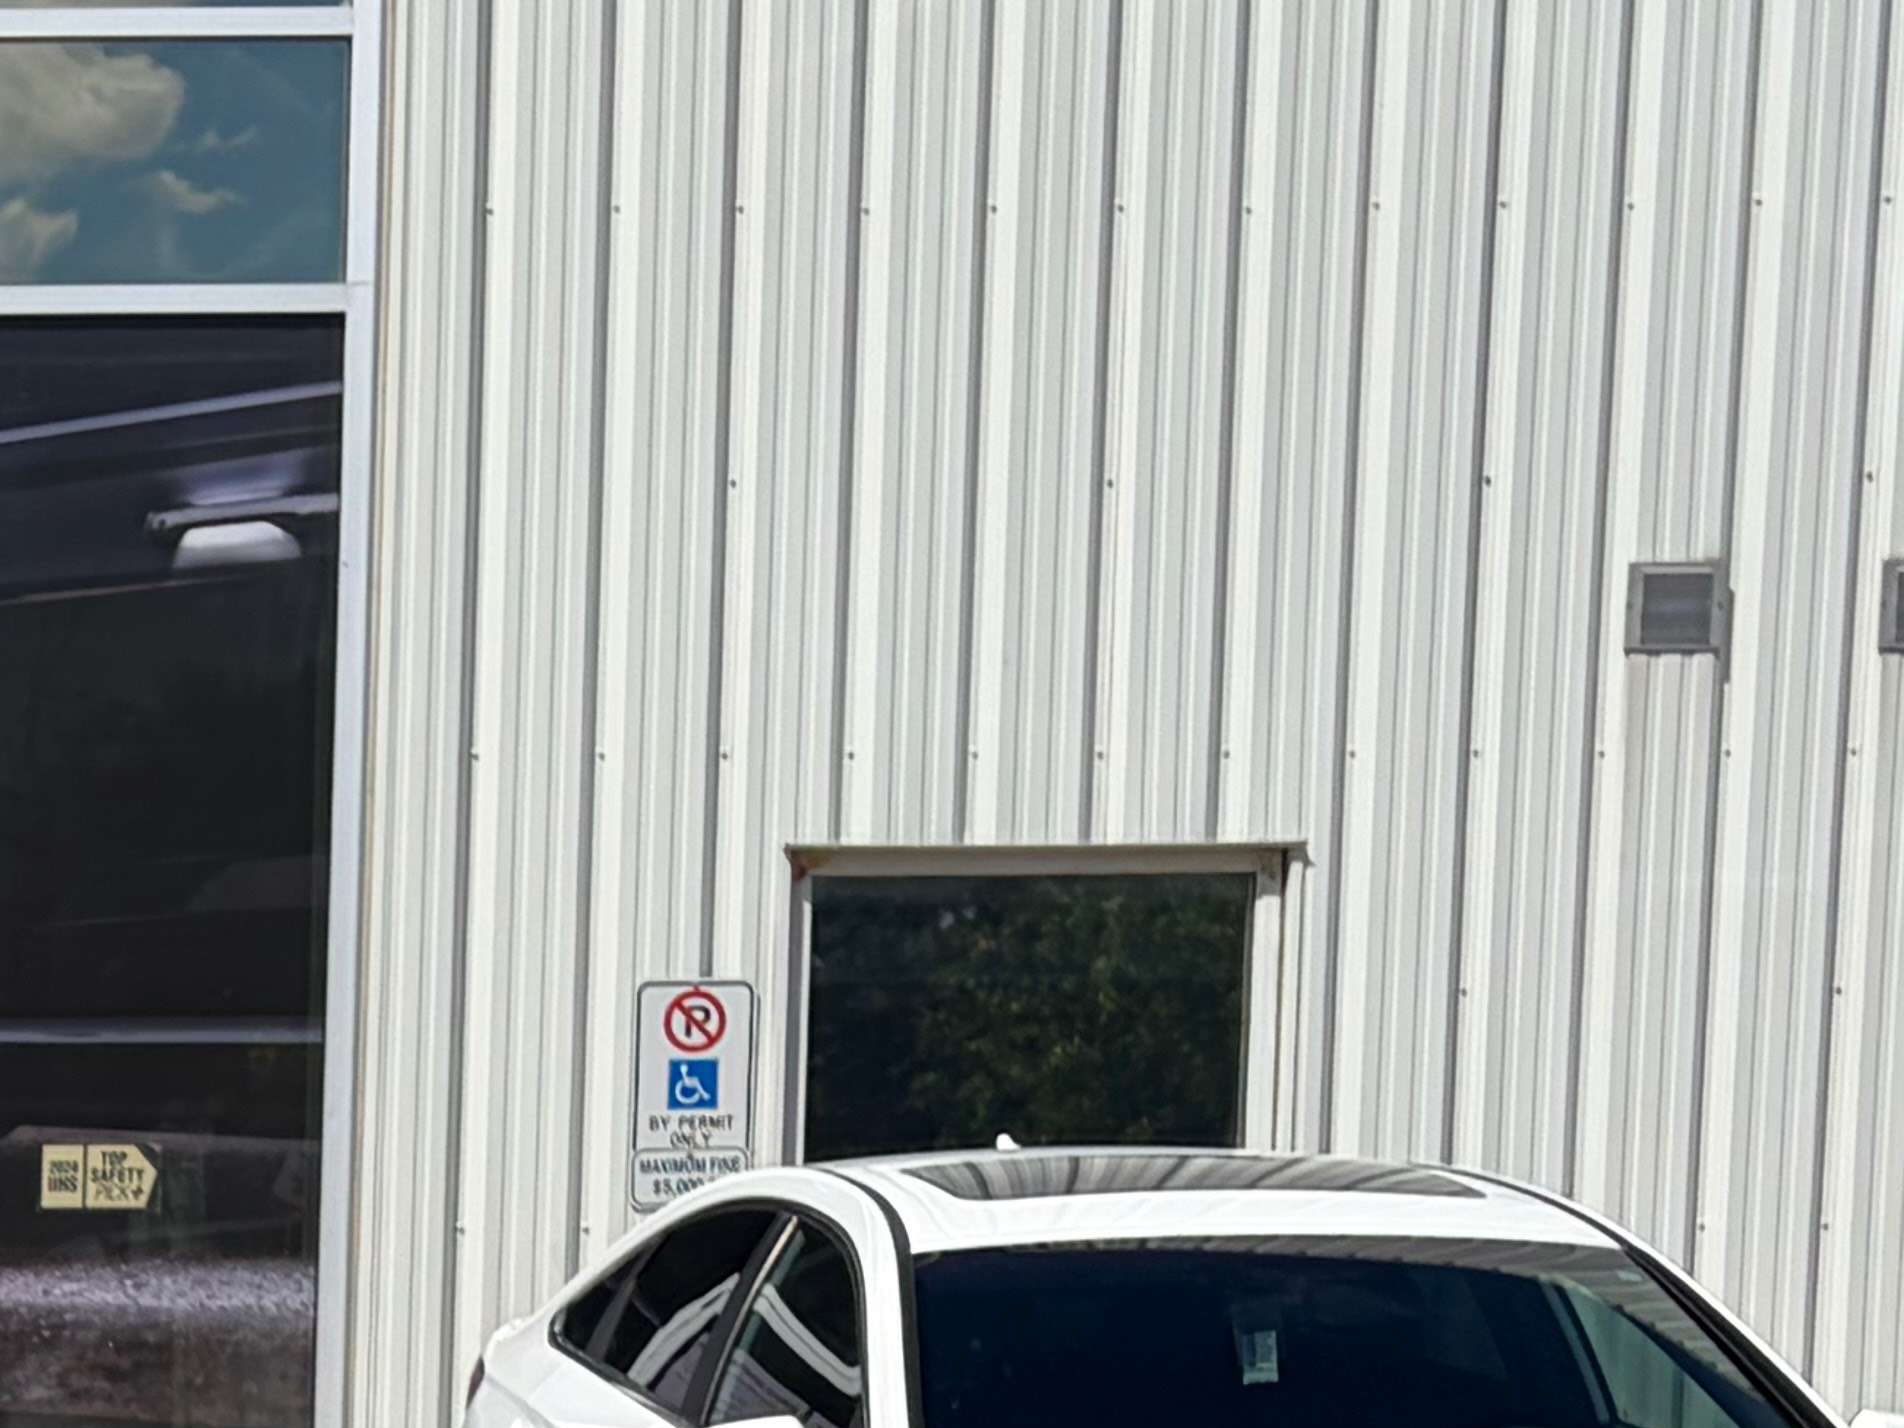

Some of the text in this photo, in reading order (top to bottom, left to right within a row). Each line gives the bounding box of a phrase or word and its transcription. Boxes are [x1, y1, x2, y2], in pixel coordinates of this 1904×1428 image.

[649, 1113, 735, 1131] BY PERMIT
[670, 1132, 713, 1149] ONLY
[100, 1150, 128, 1166] TOP
[639, 1155, 708, 1174] MAXIMUM
[90, 1167, 145, 1183] SAFETY
